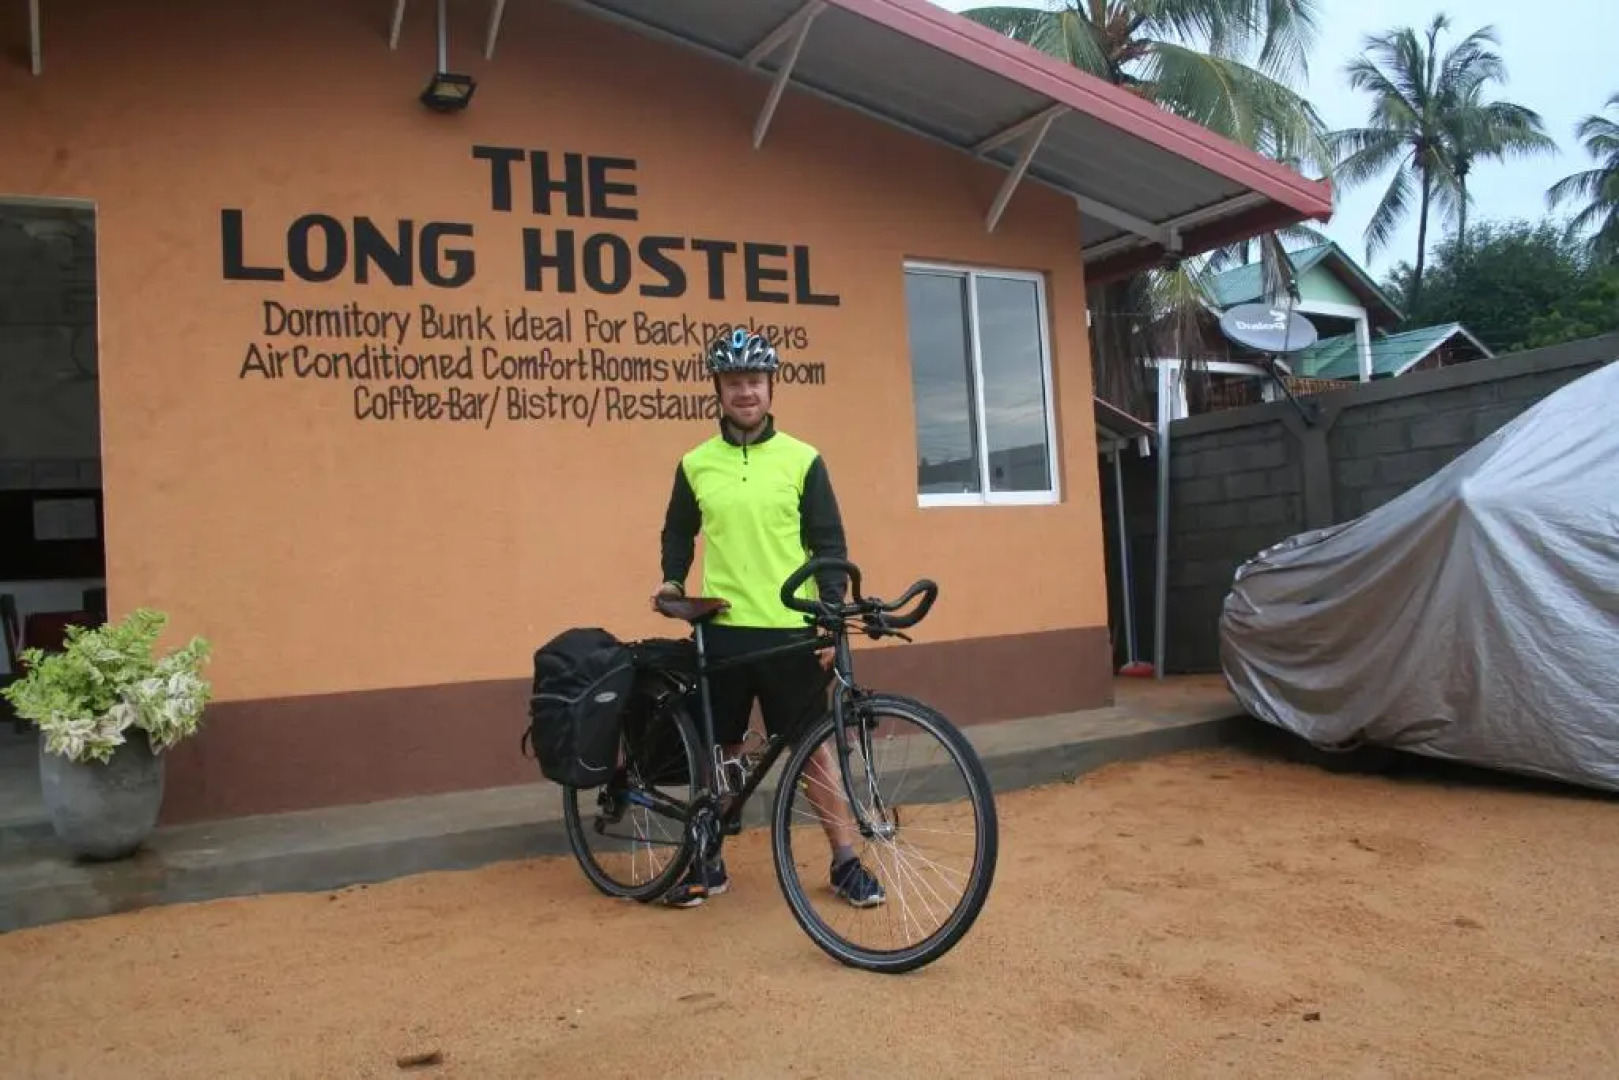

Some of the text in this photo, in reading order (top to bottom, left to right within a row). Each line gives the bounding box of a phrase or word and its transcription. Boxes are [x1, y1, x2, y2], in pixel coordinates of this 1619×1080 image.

[472, 144, 638, 221] THE
[221, 208, 841, 306] LONG HOSTEL
[263, 300, 411, 345] Dormitory
[421, 303, 496, 341] Bunk
[505, 306, 572, 342] ideal
[634, 311, 809, 350] Backpakers
[605, 387, 721, 422] Restaura
